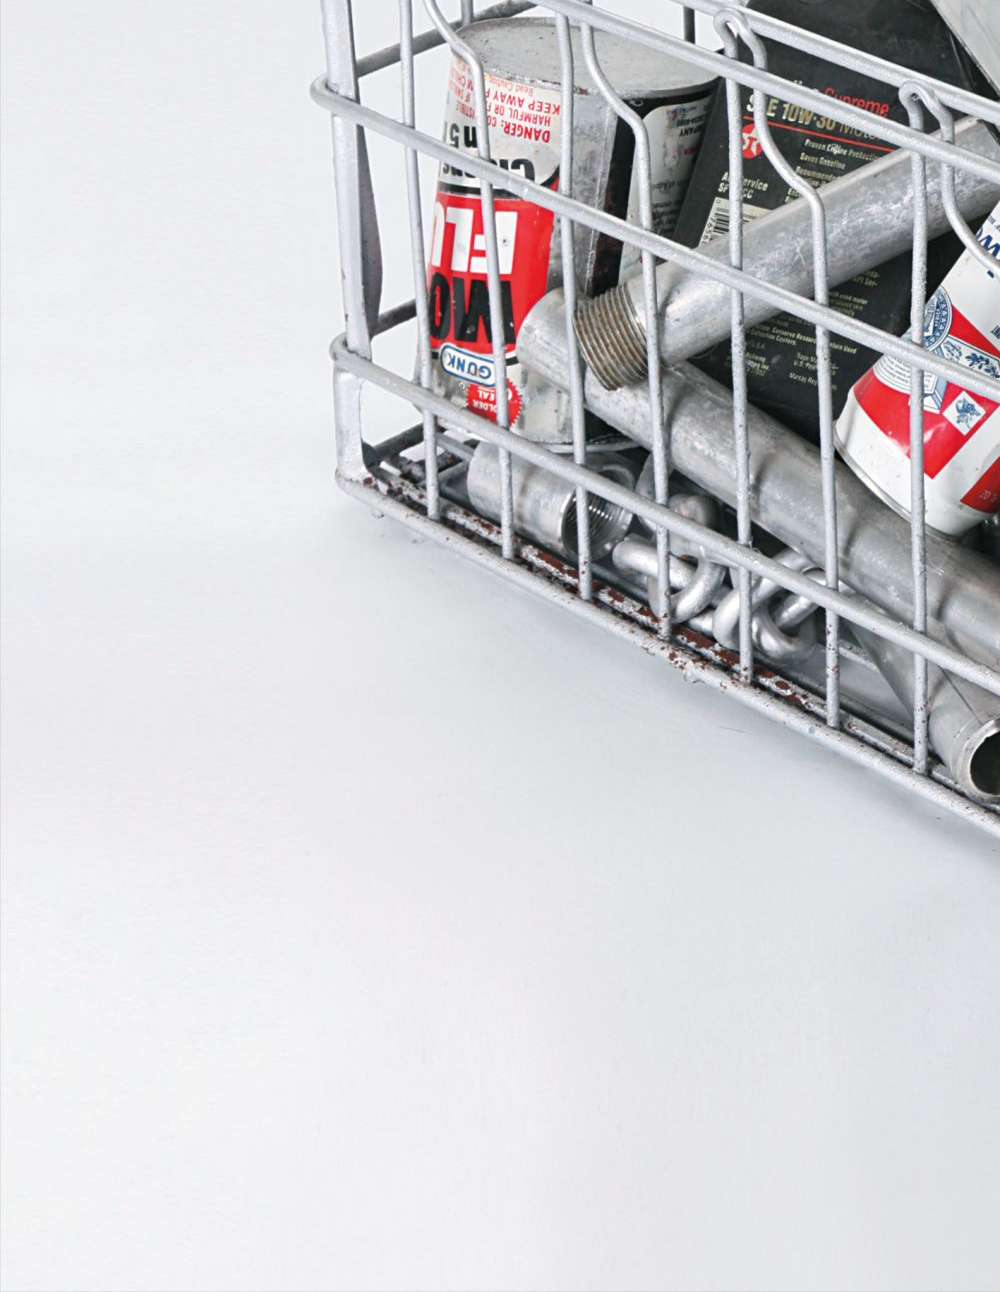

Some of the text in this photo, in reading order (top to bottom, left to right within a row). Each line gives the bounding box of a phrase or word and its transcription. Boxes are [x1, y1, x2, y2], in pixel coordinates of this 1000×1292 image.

[516, 84, 533, 96] Read
[493, 90, 525, 108] AWAY
[746, 95, 779, 117] SE
[494, 105, 505, 116] OR
[528, 100, 561, 115] KEEP
[509, 108, 551, 126] HARMFUL
[500, 119, 551, 143] DANGER:
[804, 138, 882, 161] Proven Engine Protectio
[800, 152, 818, 164] Saves
[741, 176, 769, 191] ervice
[771, 325, 796, 338] Conserve
[447, 353, 492, 380] GUNK
